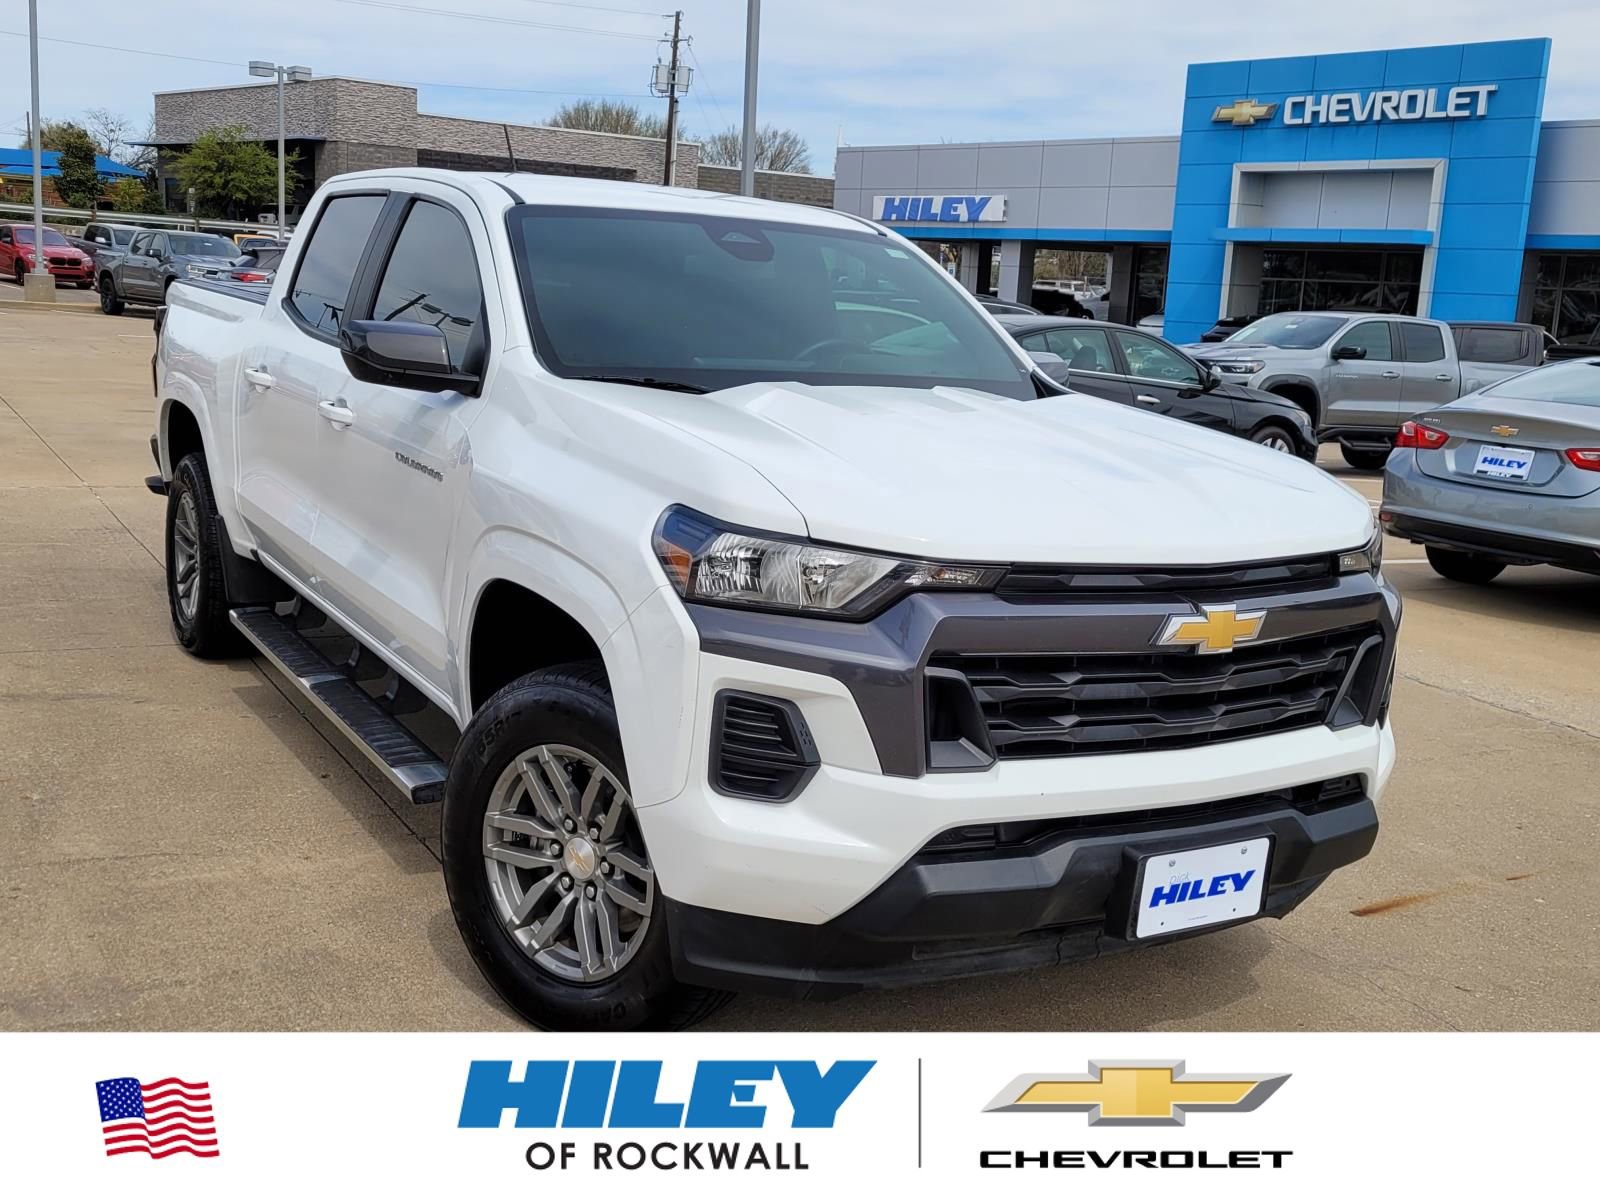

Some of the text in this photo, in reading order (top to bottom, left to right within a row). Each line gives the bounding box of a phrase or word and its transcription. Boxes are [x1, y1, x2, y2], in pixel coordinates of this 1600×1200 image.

[1283, 84, 1498, 125] CHEVROLET
[882, 196, 992, 222] HILEY
[1481, 456, 1528, 469] HILEY
[1149, 870, 1256, 908] HILEY
